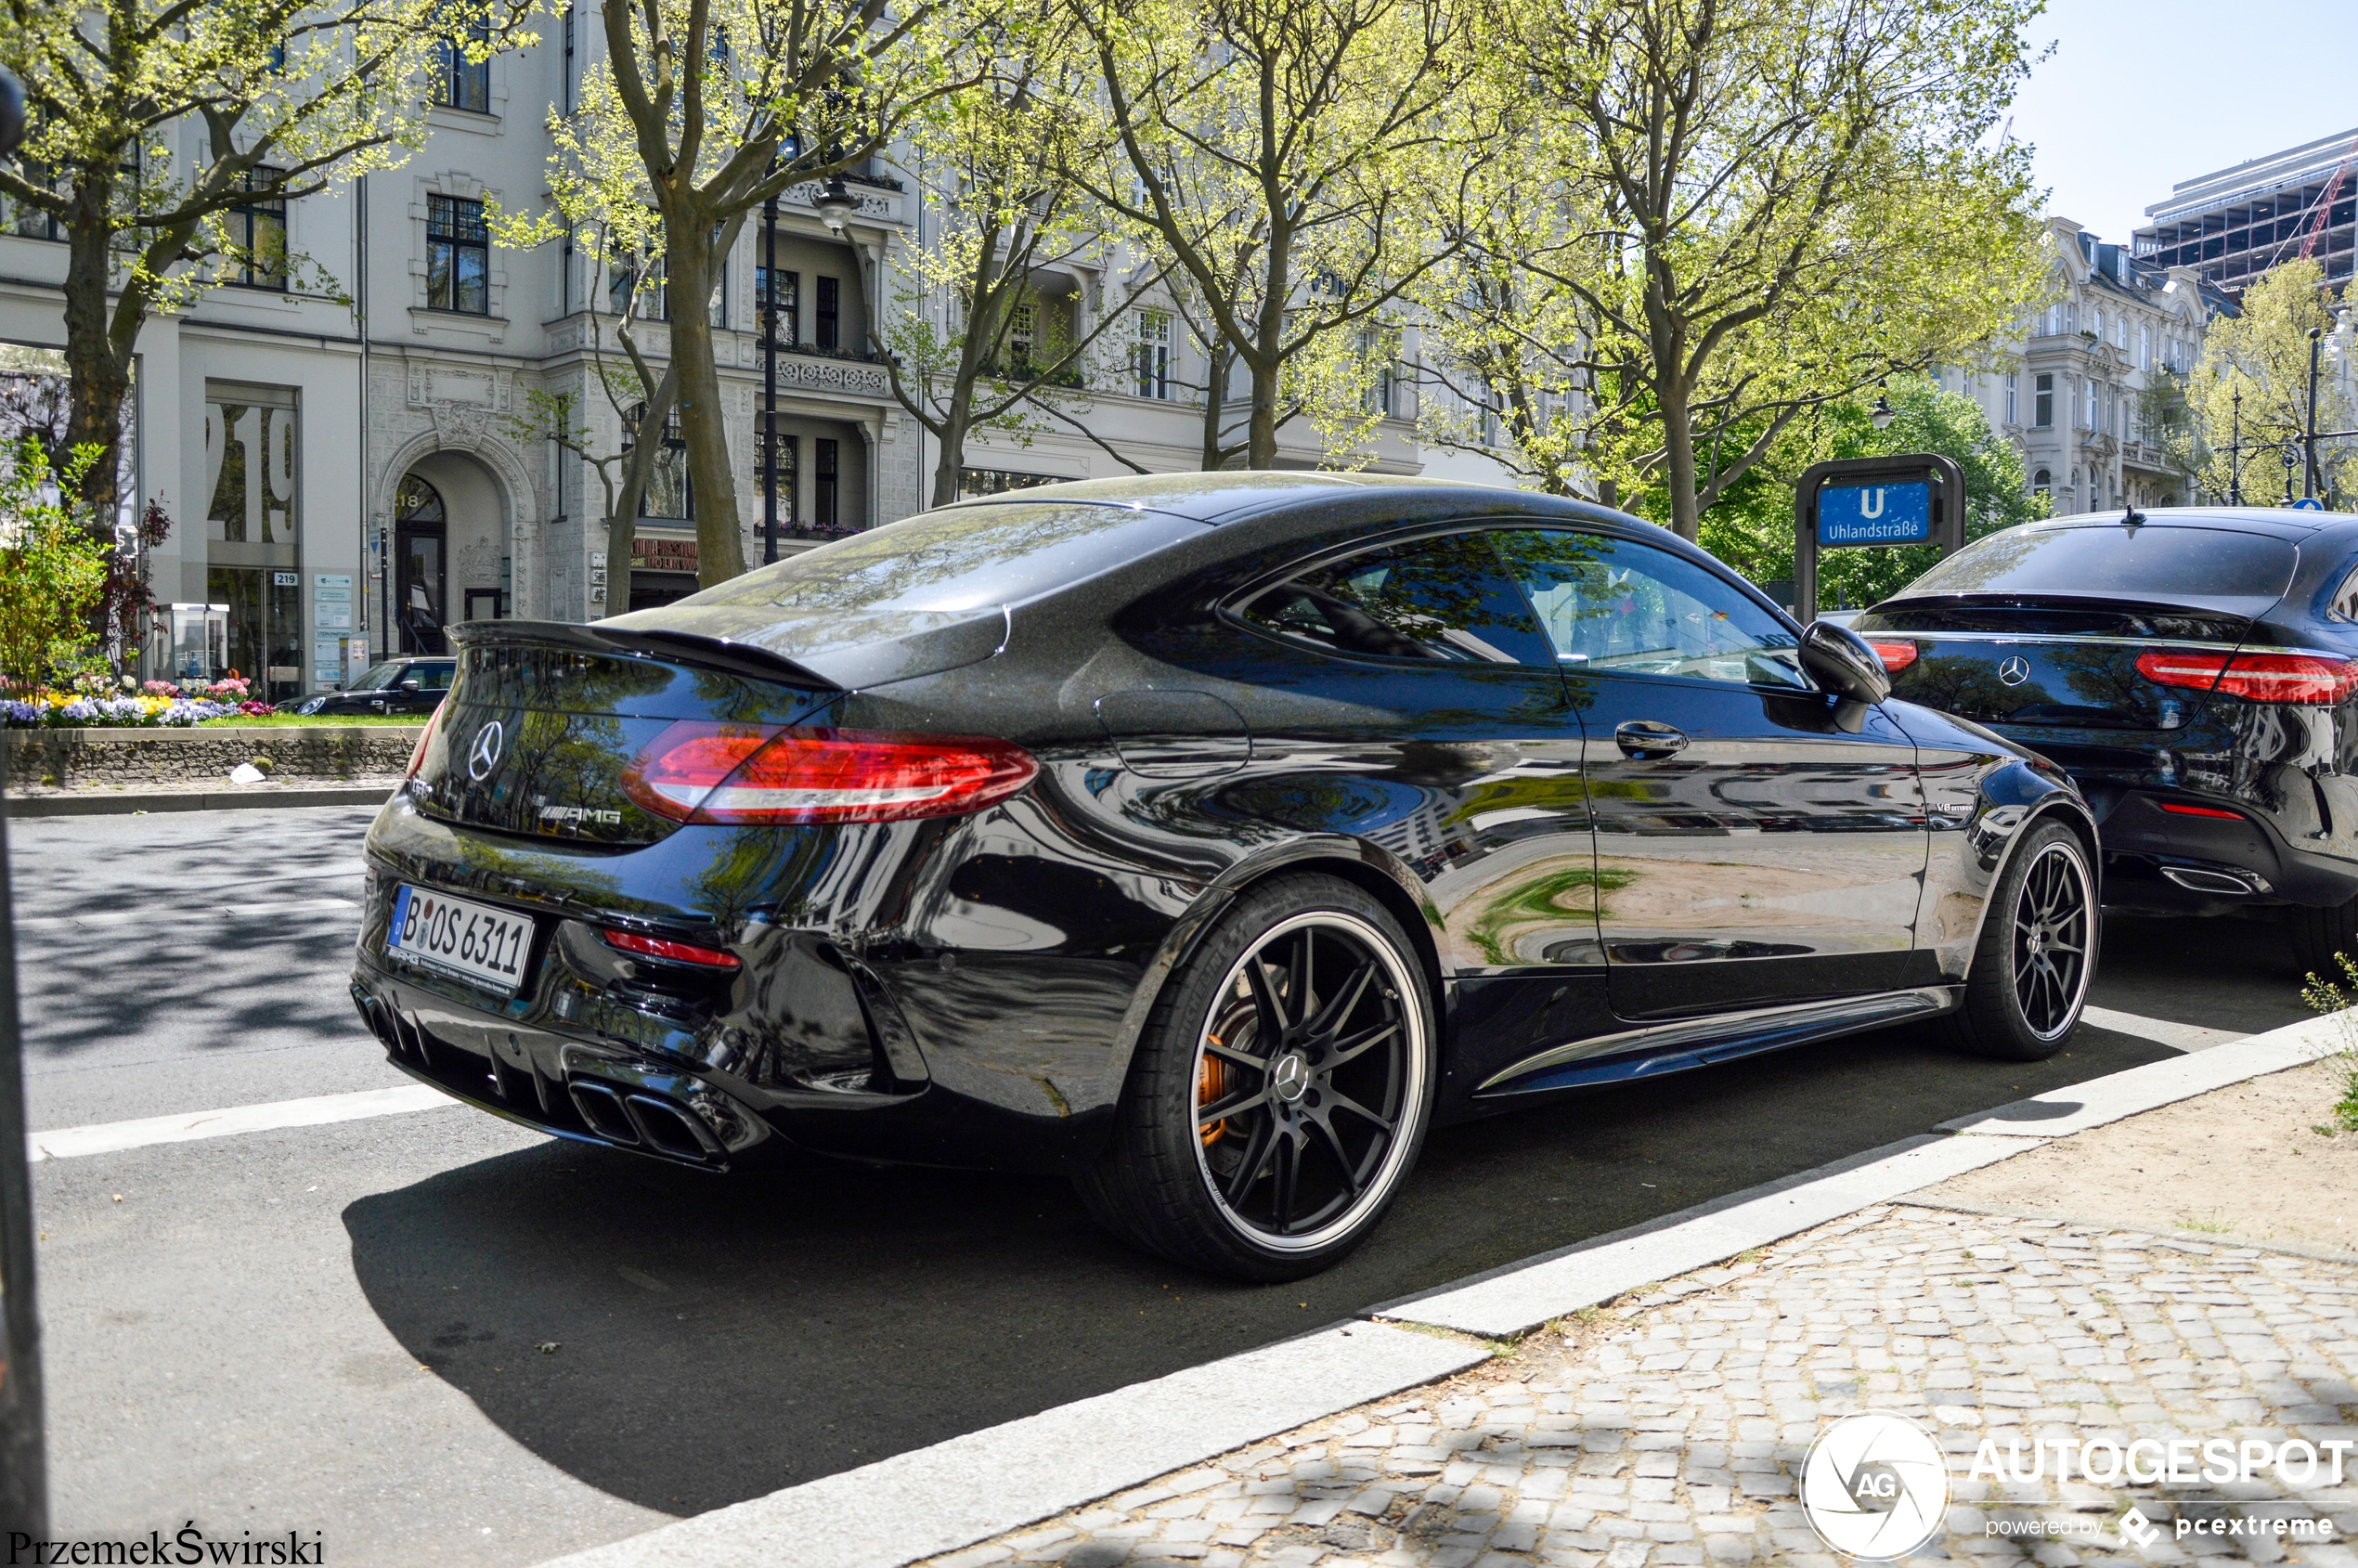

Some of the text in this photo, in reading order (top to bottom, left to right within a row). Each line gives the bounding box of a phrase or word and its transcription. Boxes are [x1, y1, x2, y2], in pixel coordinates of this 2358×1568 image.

[205, 403, 296, 544] 219
[395, 495, 419, 508] 18
[1861, 488, 1885, 519] U
[1829, 520, 1918, 539] Uhlandstraße
[680, 559, 698, 571] WA
[278, 575, 295, 584] 219
[1937, 803, 1950, 811] V8
[564, 807, 621, 824] AMG
[395, 922, 402, 935] D
[402, 896, 523, 975] B OS 6311
[396, 951, 420, 965] AMG
